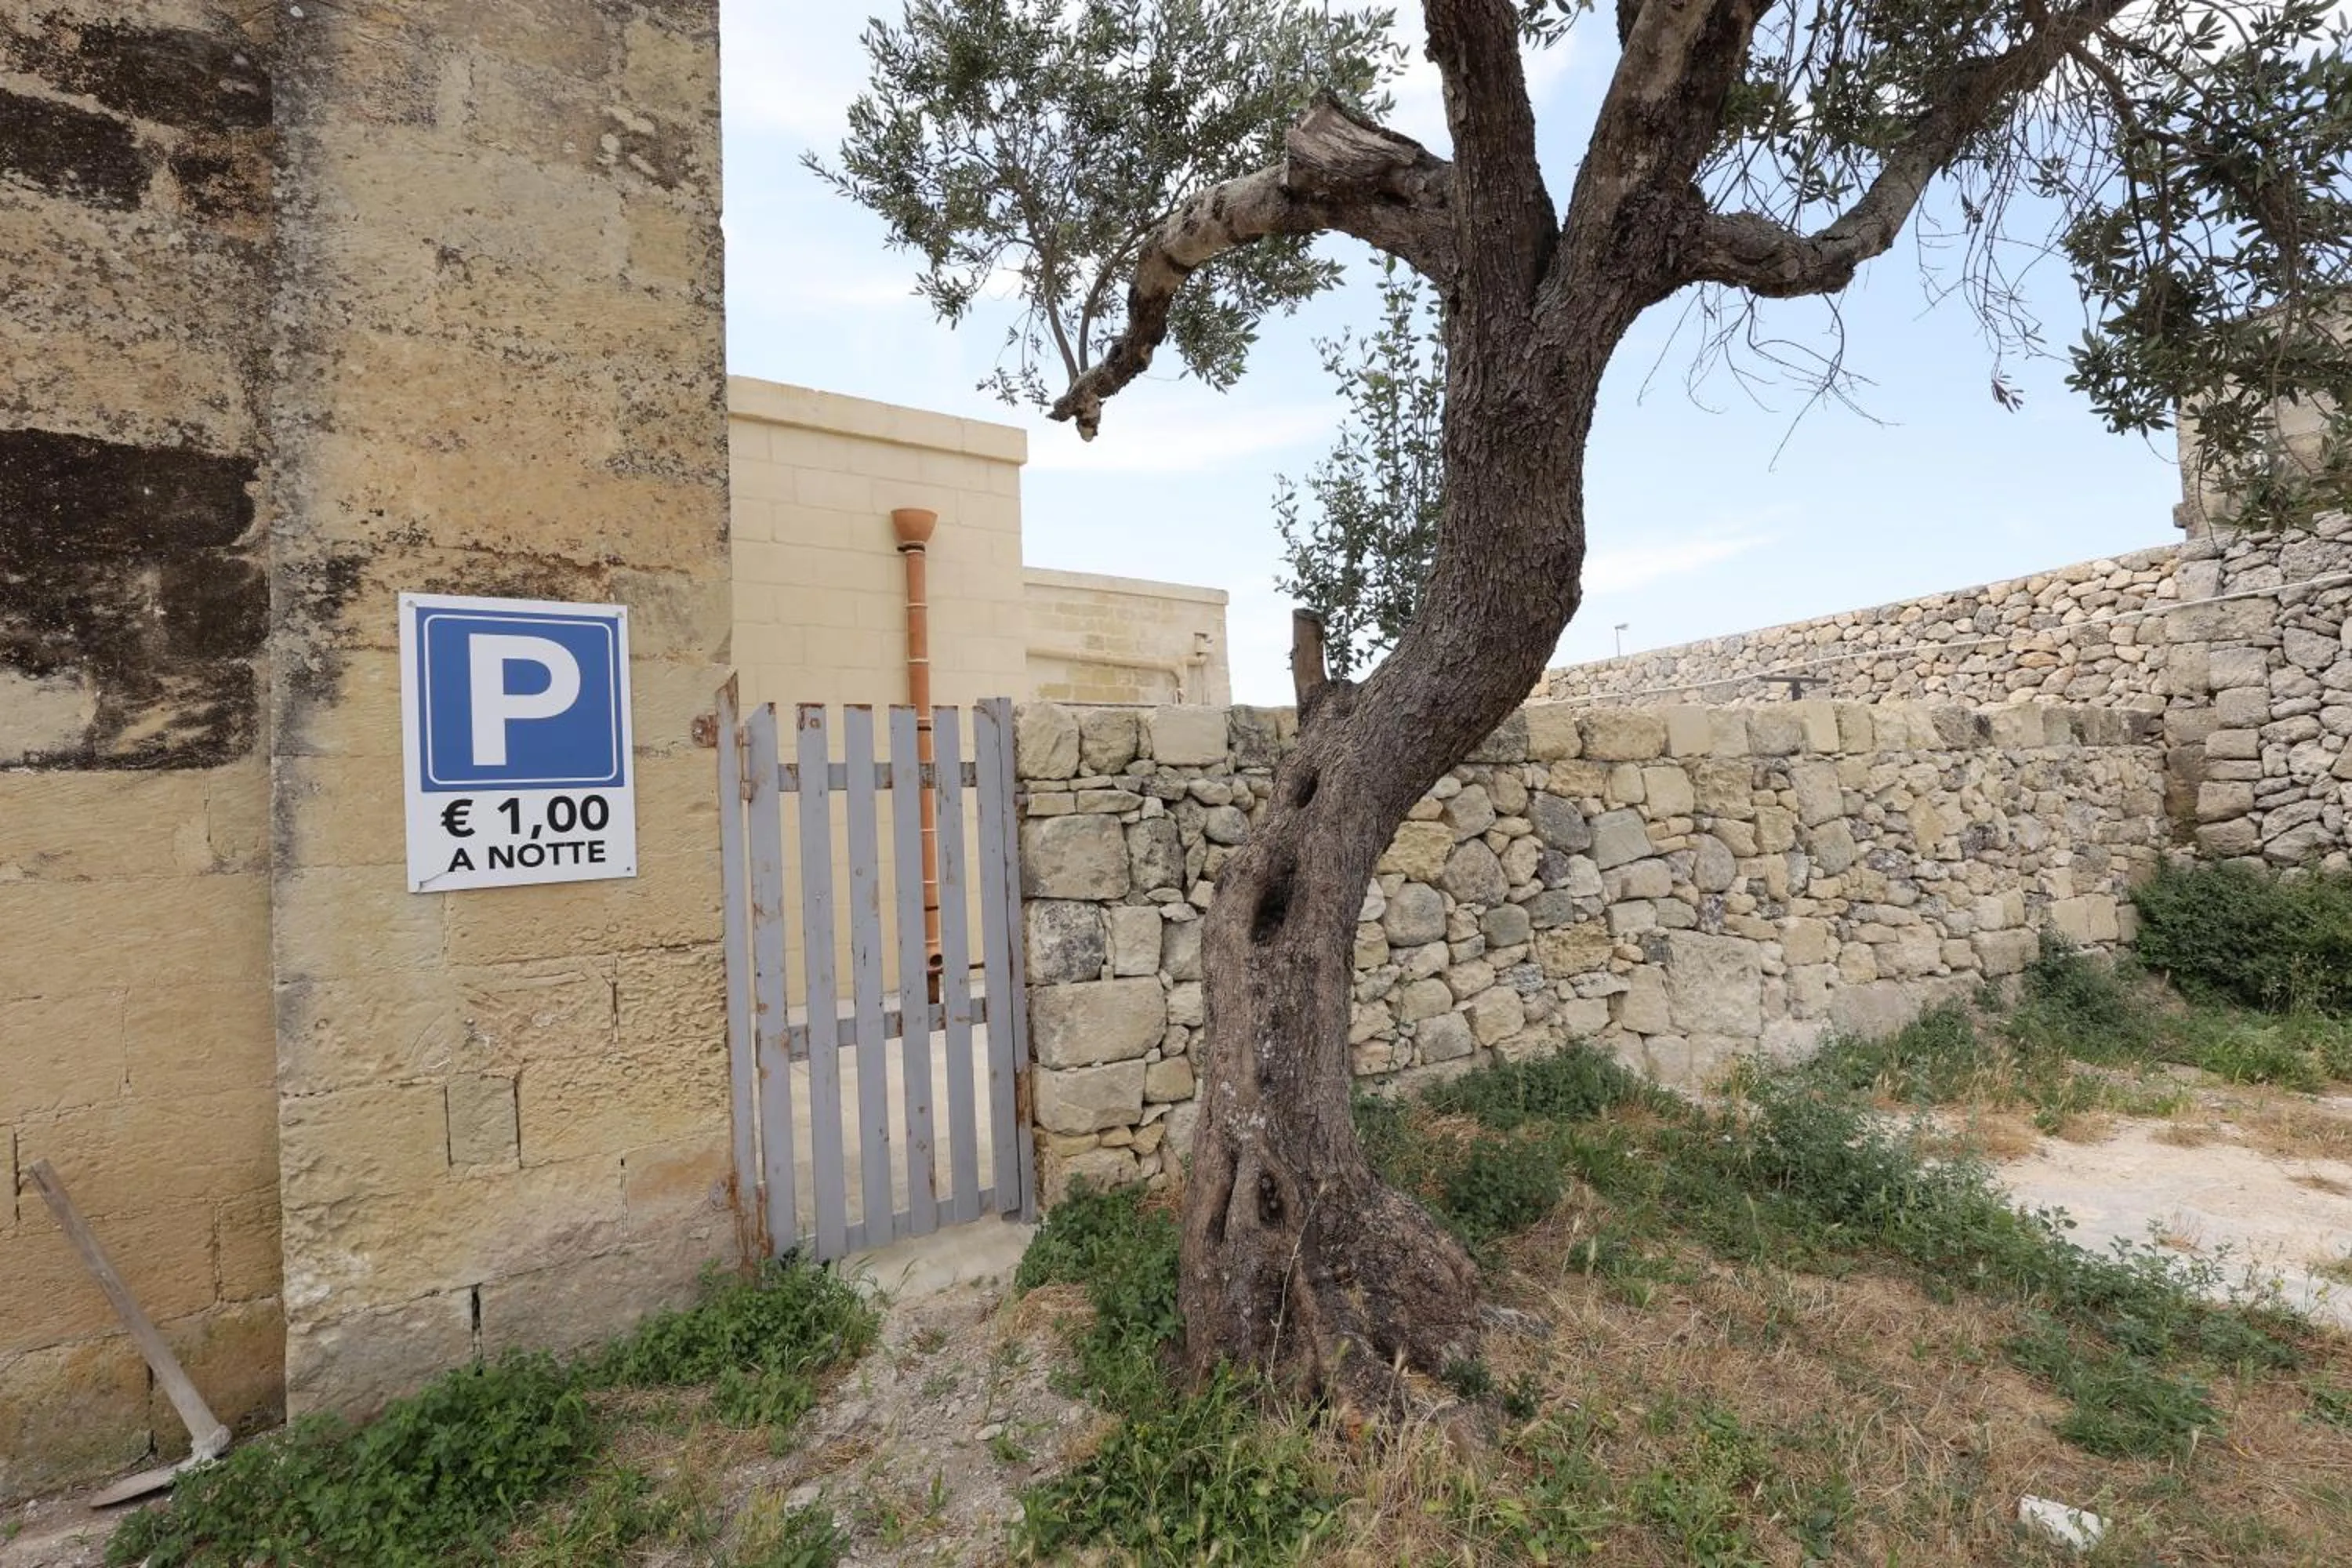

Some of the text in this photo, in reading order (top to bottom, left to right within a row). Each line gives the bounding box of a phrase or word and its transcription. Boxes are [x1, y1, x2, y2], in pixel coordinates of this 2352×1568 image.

[469, 633, 581, 766] P
[441, 794, 610, 840] € 1,00
[448, 840, 606, 873] A NOTTE
